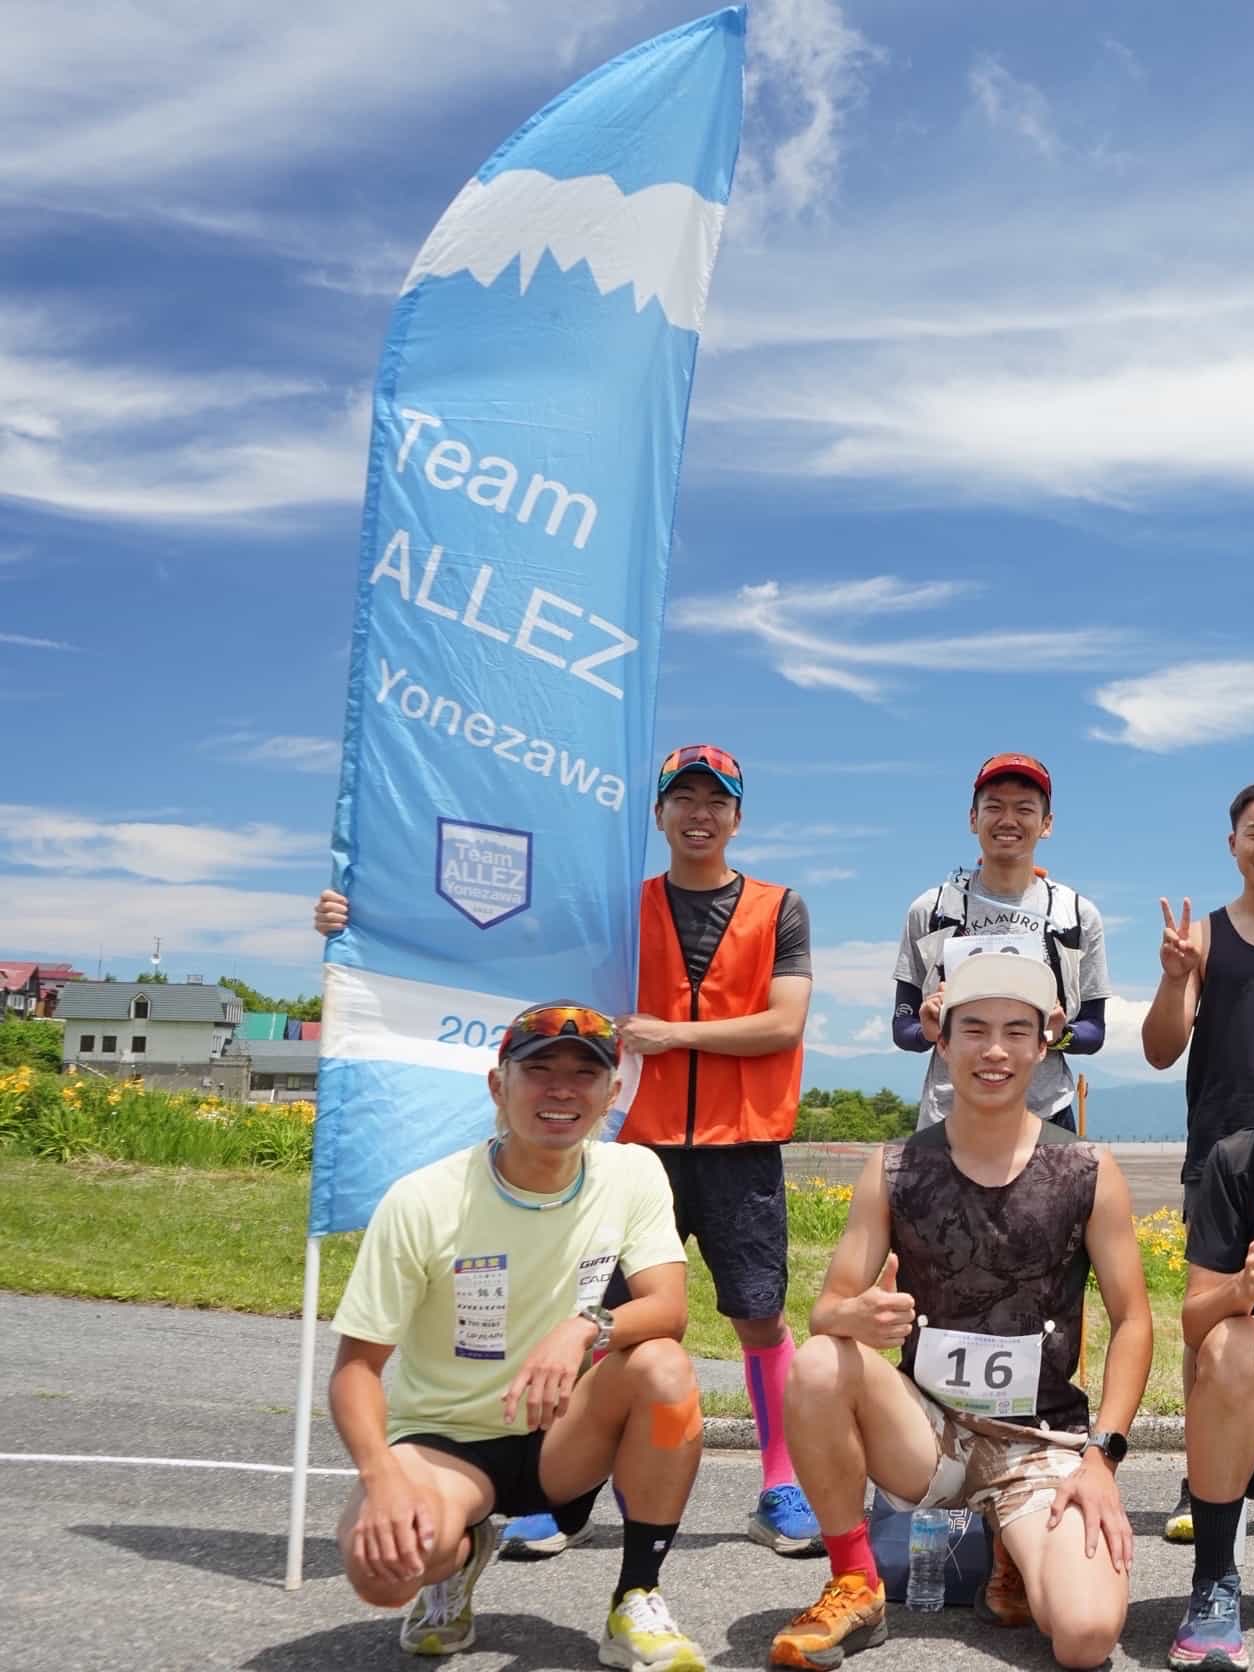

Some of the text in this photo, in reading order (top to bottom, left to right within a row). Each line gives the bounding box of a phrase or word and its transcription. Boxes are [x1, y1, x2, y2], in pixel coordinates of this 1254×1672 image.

[396, 408, 599, 549] Team
[369, 529, 638, 700] ALLEZ
[375, 658, 625, 812] Yonezawa
[445, 859, 524, 890] ALLEZ
[456, 843, 512, 867] Team
[945, 1347, 1013, 1389] 16
